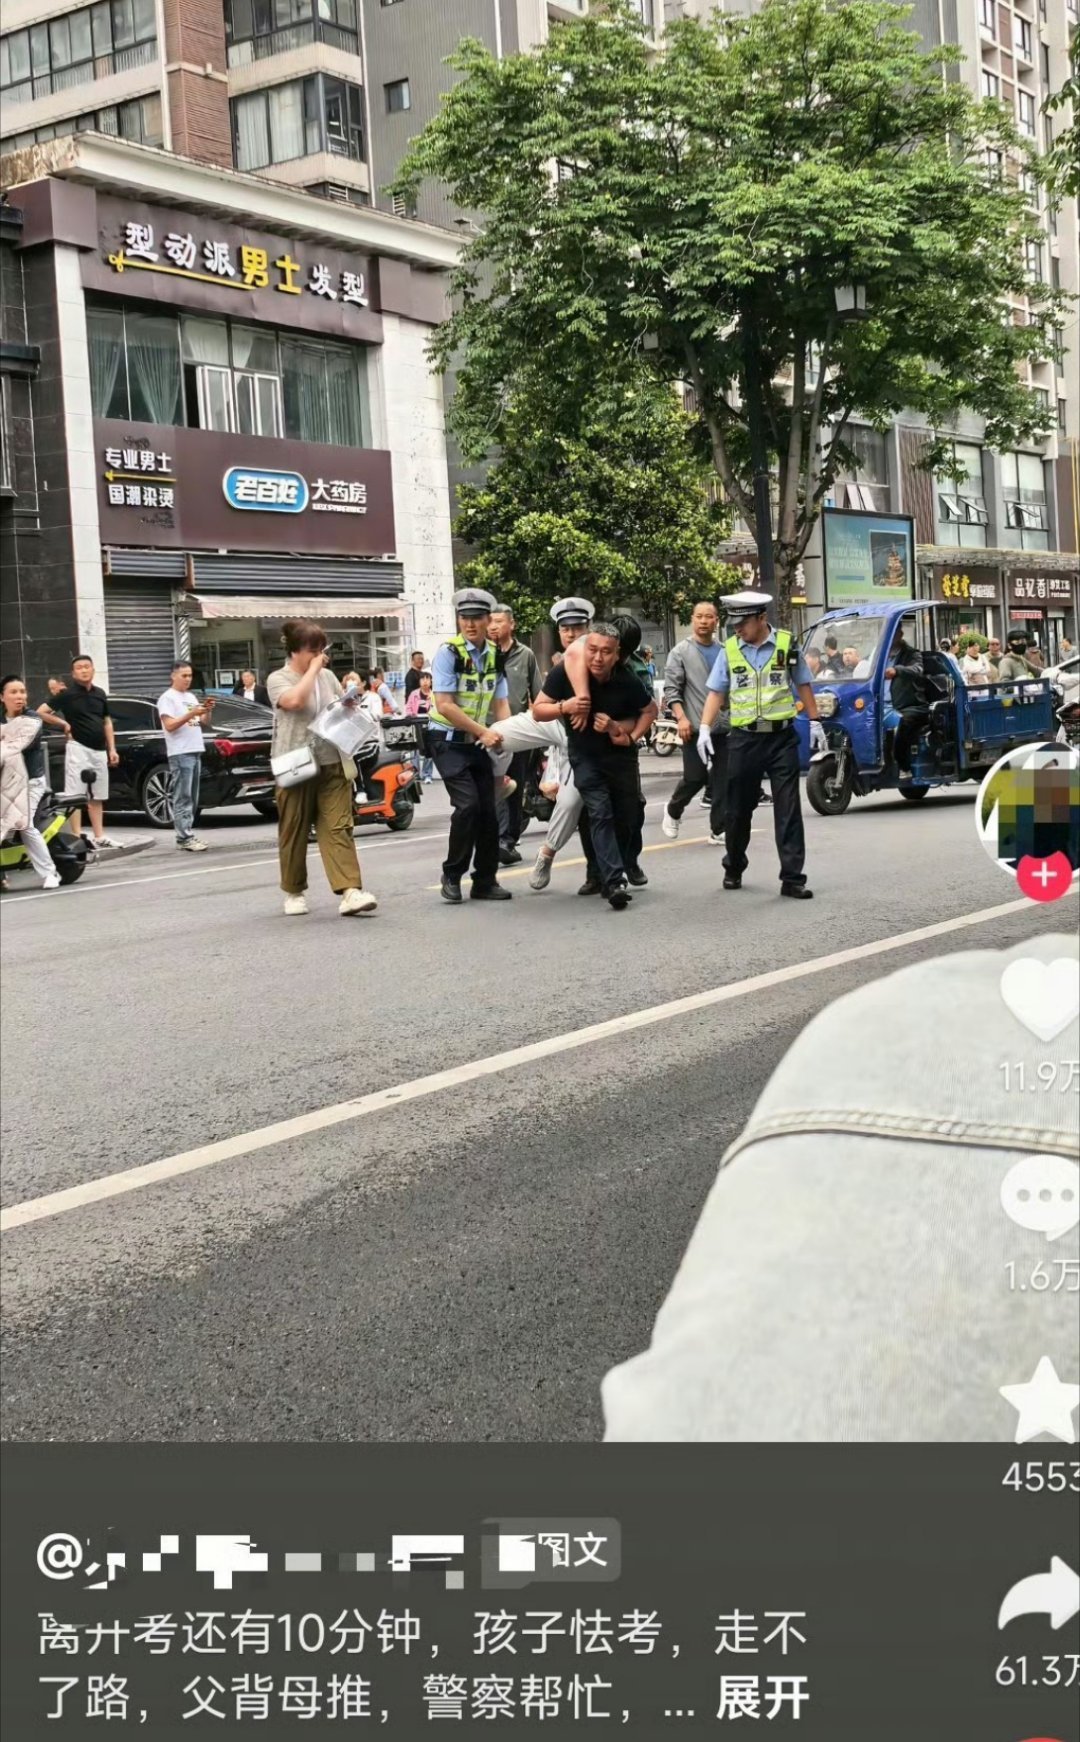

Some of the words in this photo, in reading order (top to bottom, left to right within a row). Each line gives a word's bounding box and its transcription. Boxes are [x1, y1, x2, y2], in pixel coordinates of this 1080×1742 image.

[125, 221, 370, 308] 型动派男士发型
[105, 447, 172, 472] 专业男士
[108, 484, 174, 509] 国潮染烫
[234, 474, 300, 505] 老百姓
[310, 478, 367, 504] 大药房
